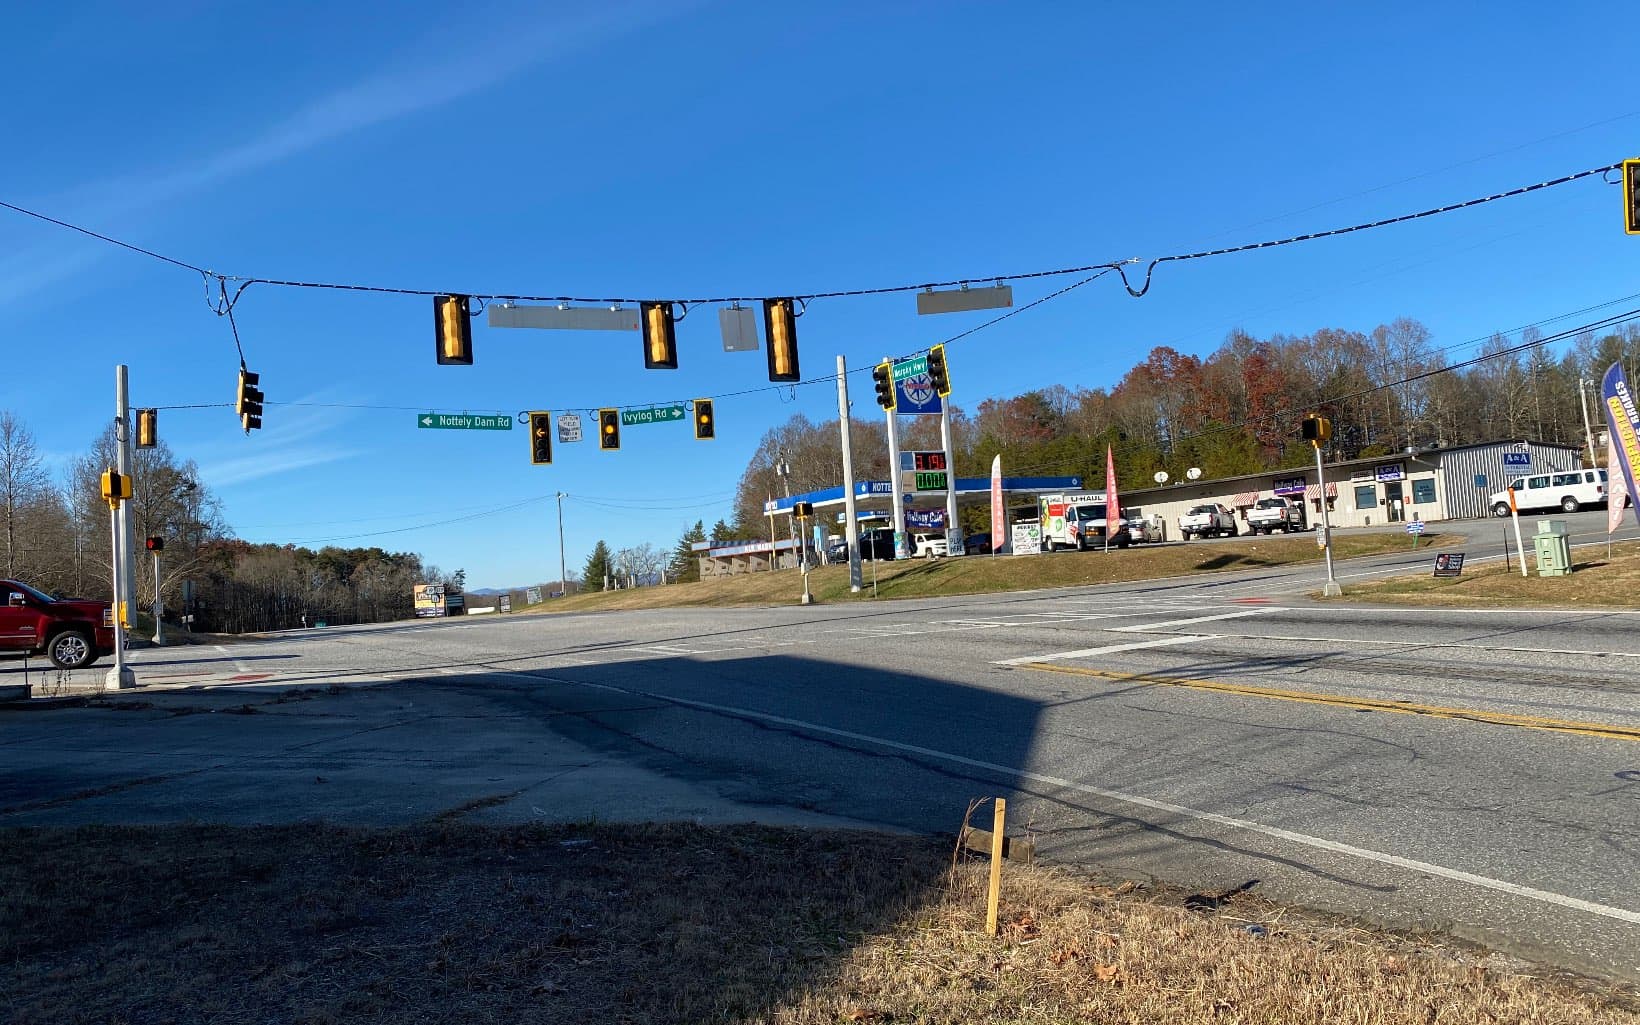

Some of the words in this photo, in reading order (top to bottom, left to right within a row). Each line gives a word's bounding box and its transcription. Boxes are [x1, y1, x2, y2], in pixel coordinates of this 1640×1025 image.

[913, 362, 925, 372] Hwy
[1615, 381, 1640, 424] BRAKES
[439, 415, 472, 428] Nottely
[474, 416, 495, 427] Dam
[497, 417, 510, 427] Rd
[623, 410, 652, 422] Ivylog
[655, 408, 667, 419] Rd
[1609, 397, 1640, 481] INSPECTION
[872, 482, 892, 492] NOTTE
